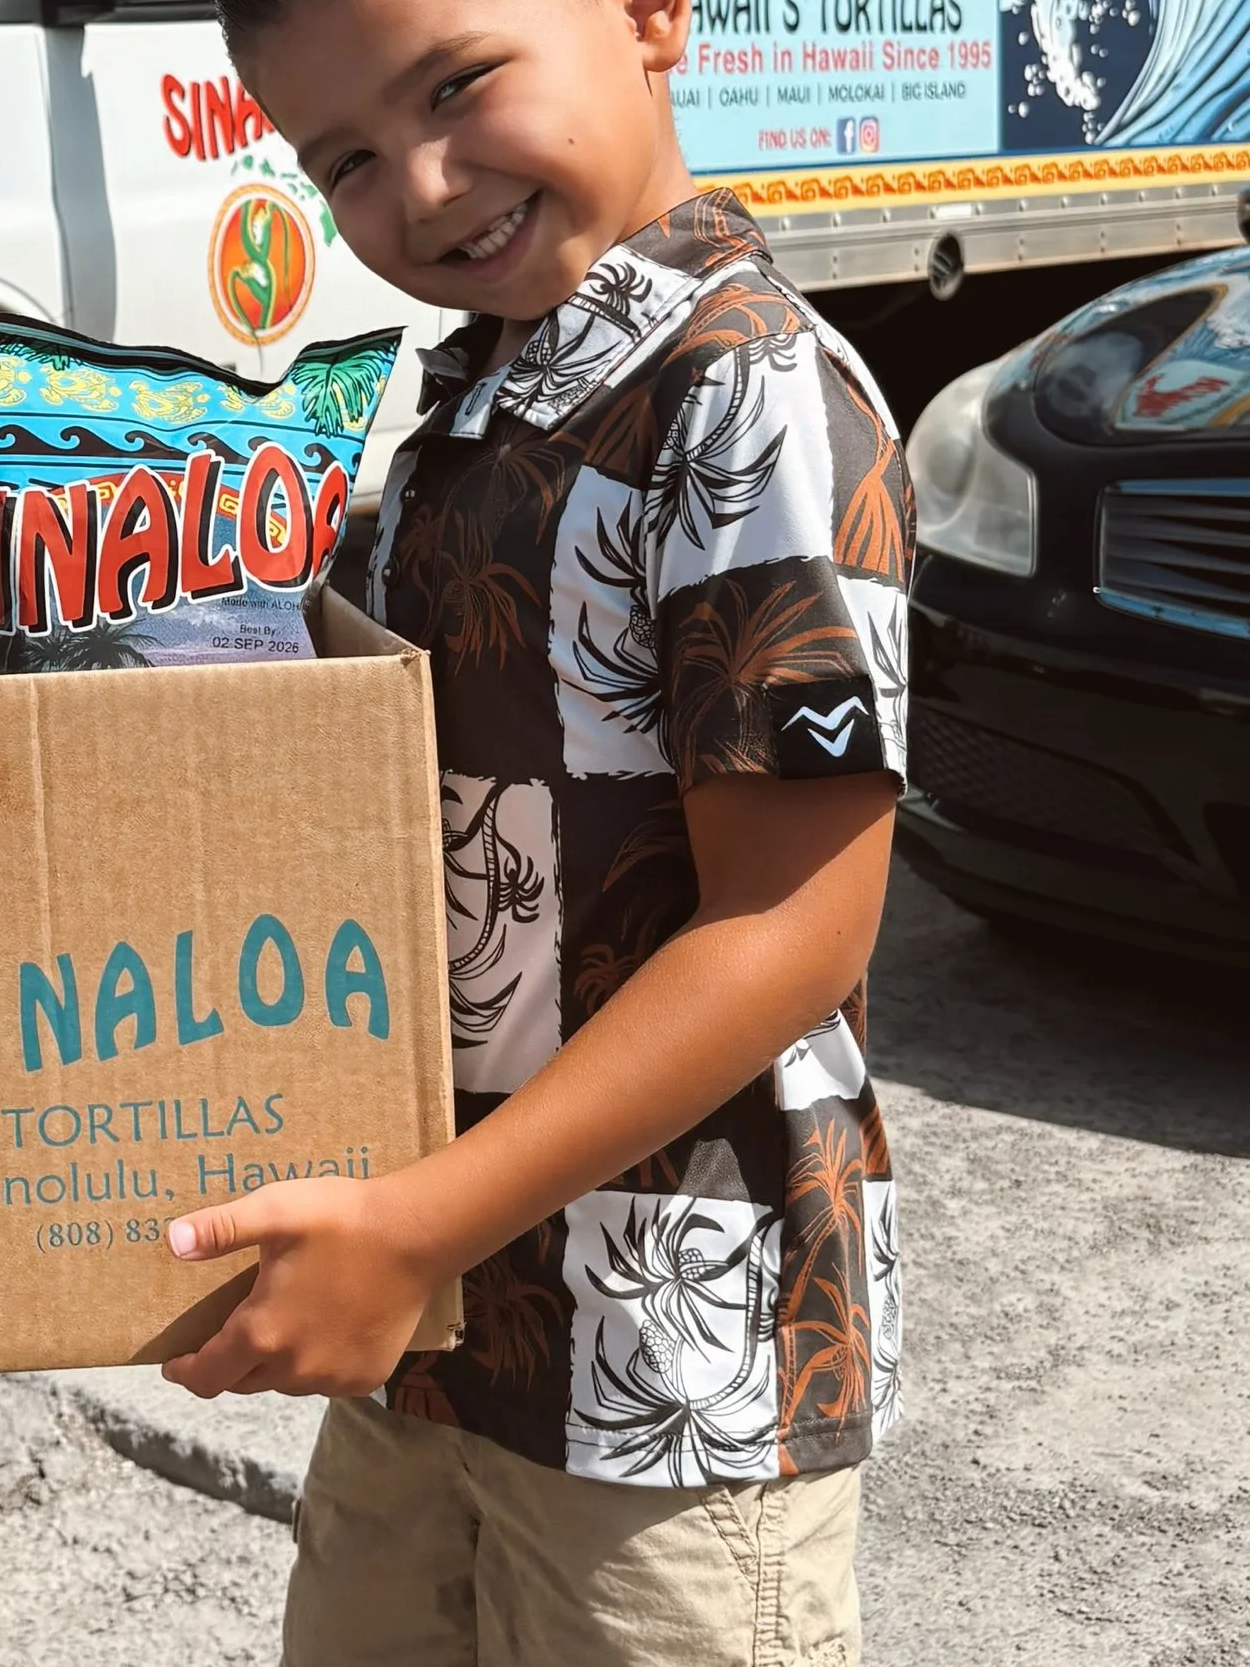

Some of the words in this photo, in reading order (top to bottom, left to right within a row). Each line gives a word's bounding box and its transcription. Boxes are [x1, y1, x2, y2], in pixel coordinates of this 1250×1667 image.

[698, 40, 763, 76] Fresh
[773, 40, 793, 73] in
[802, 40, 874, 72] Hawaii
[882, 39, 940, 70] Since
[948, 38, 992, 70] 1995
[719, 86, 759, 108] OAHU
[777, 85, 811, 105] MAUI
[161, 73, 275, 161] SINA
[758, 130, 787, 151] FIND
[789, 127, 807, 148] US
[251, 599, 269, 609] with
[240, 624, 261, 635] Best
[212, 636, 230, 649] 02
[234, 638, 264, 651] SEP
[268, 640, 299, 654] 2026
[0, 1093, 285, 1150] TORTILLAS
[36, 1218, 114, 1254] (808)
[125, 1216, 174, 1243] 83
